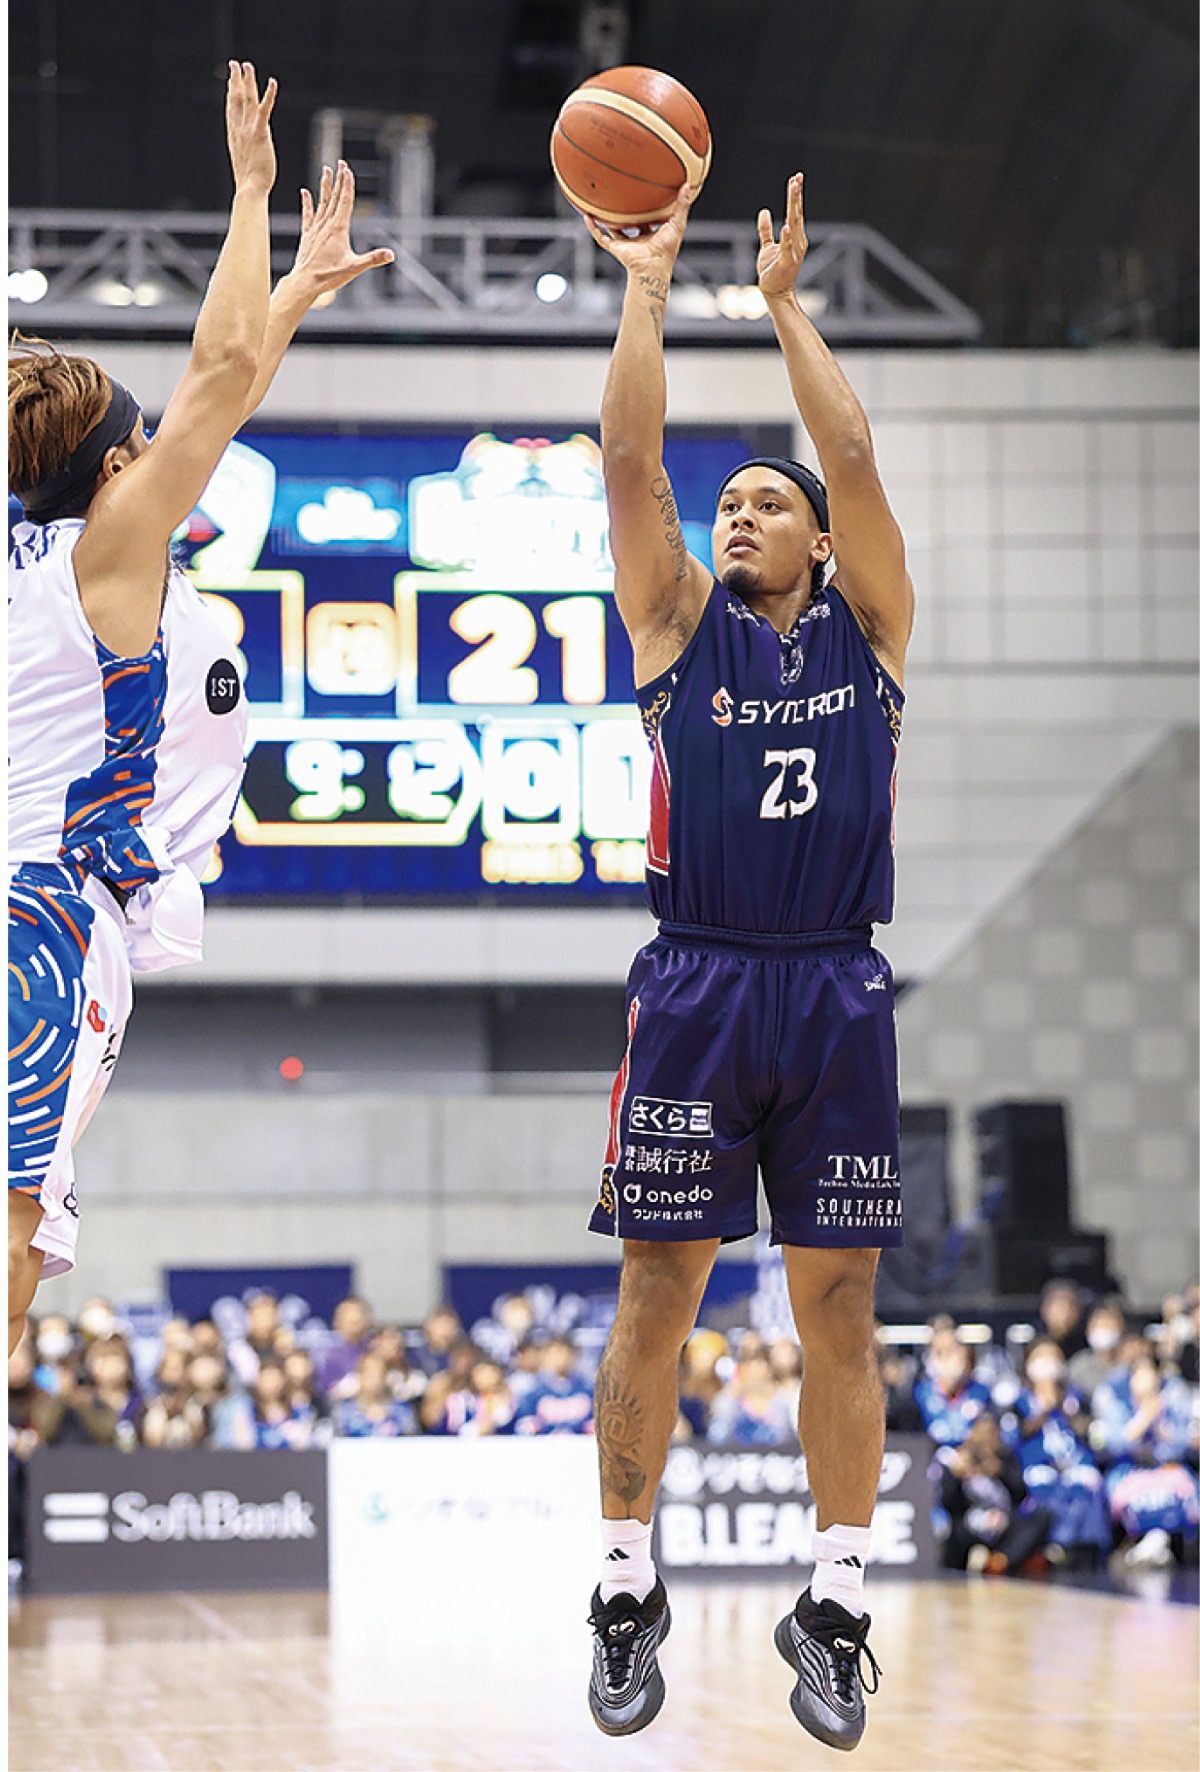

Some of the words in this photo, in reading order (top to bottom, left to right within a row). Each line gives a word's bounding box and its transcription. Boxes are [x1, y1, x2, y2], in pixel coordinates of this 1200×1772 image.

[447, 593, 607, 706] 21
[759, 747, 819, 820] 23
[632, 1103, 687, 1131] さくら
[827, 1155, 899, 1179] TML
[646, 1184, 713, 1204] onedo
[111, 1491, 316, 1542] SoftBank
